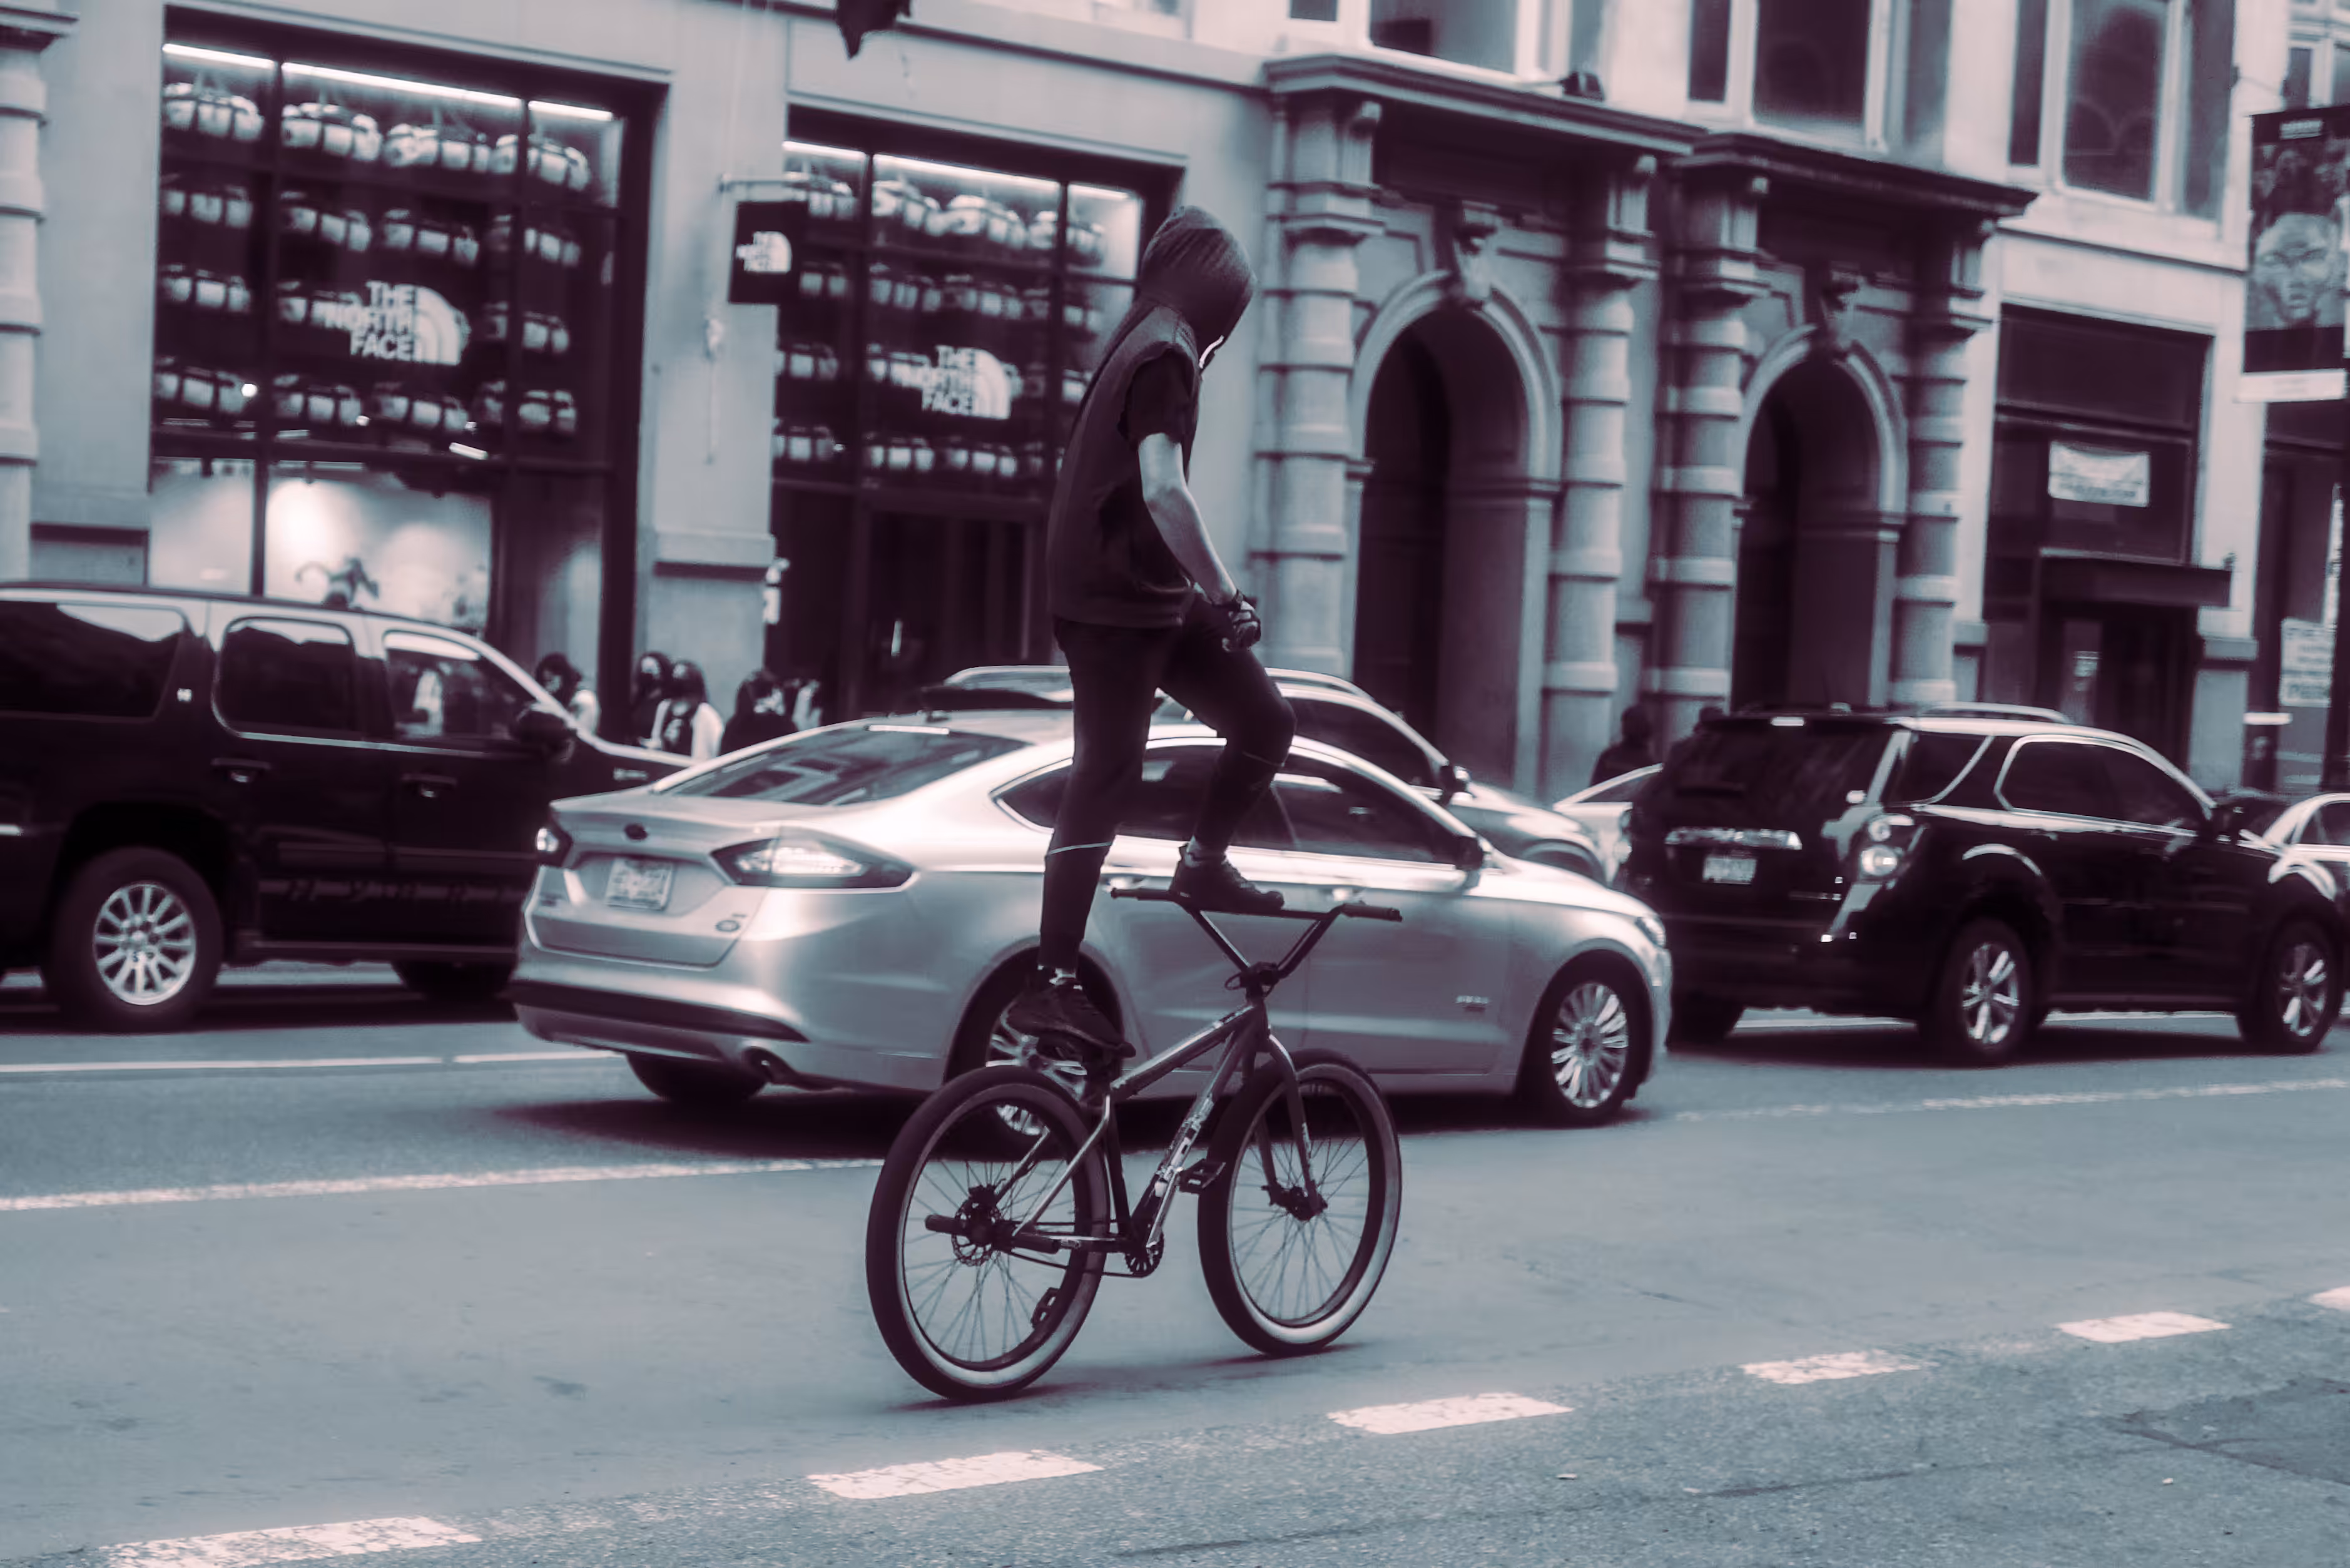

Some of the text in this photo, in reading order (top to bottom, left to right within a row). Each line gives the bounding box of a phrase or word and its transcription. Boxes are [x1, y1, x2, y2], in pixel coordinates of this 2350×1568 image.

[366, 281, 414, 307] THE
[325, 304, 413, 334] NORTH
[350, 328, 412, 361] FACE
[937, 345, 974, 369] THE
[922, 389, 973, 415] FACE
